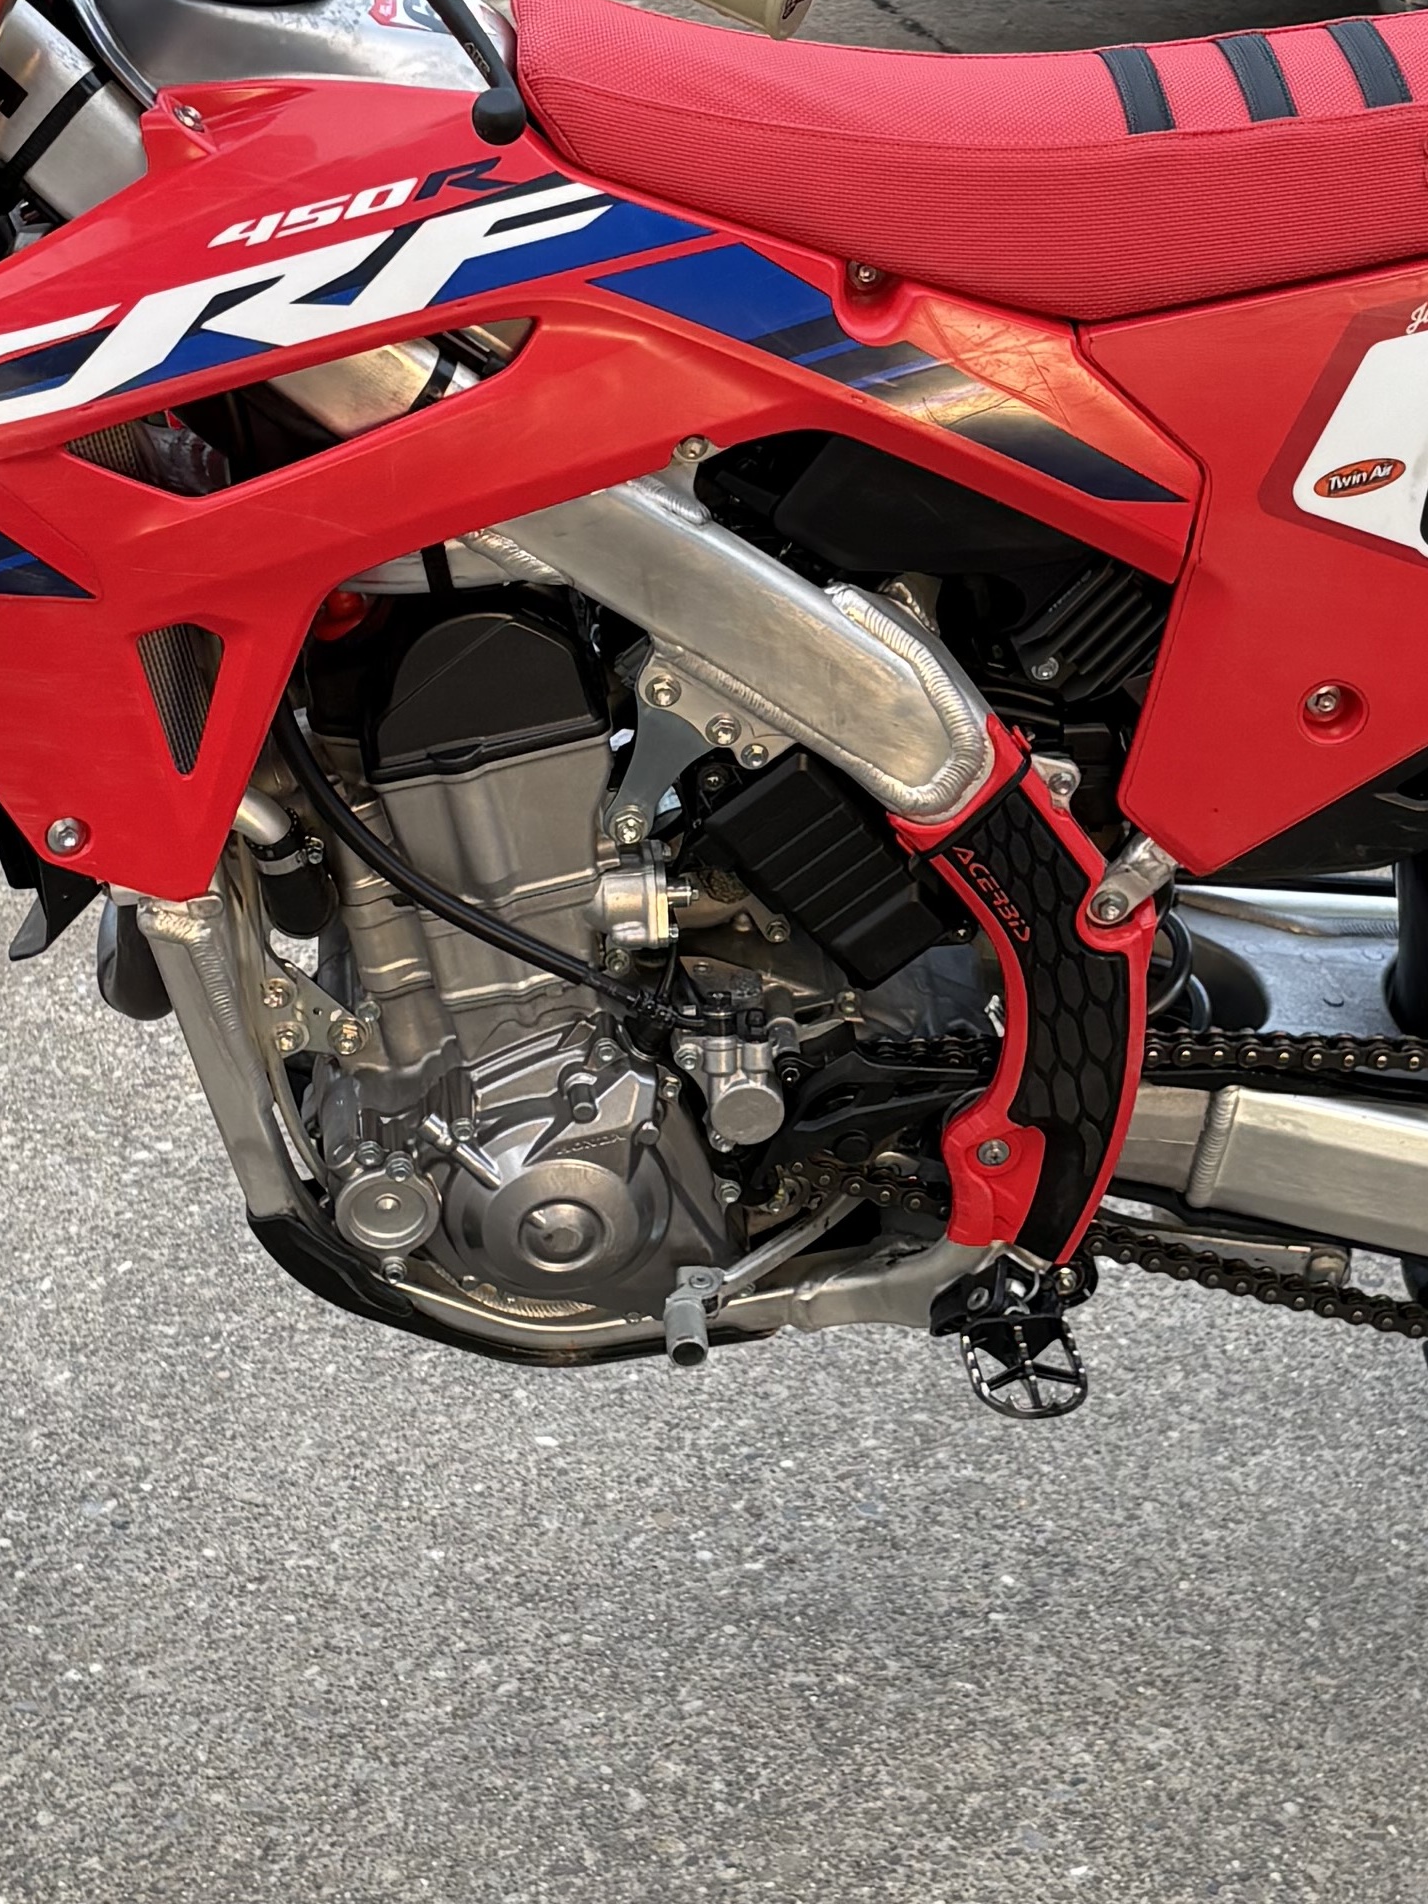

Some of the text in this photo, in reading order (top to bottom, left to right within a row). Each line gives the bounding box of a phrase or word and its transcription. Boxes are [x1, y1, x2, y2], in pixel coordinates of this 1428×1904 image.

[208, 157, 537, 249] 450R
[1328, 460, 1394, 494] Twin Air
